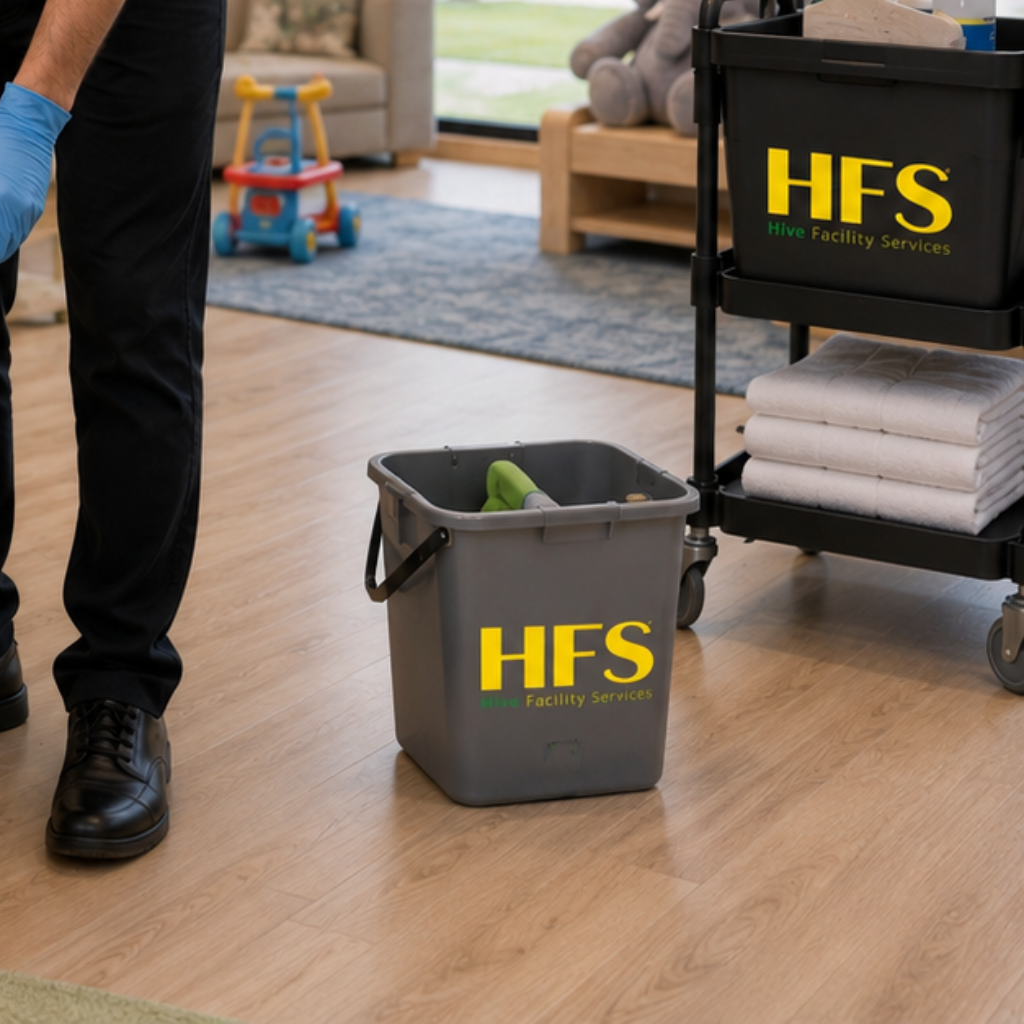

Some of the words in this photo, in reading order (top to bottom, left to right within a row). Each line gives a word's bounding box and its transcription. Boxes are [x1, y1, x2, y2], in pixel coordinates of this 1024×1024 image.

[767, 147, 953, 234] HFS
[768, 221, 805, 239] Hive
[811, 226, 875, 250] Facility
[881, 234, 951, 256] Services
[480, 620, 654, 691] HFS
[526, 692, 586, 708] Facility
[591, 689, 652, 704] Services
